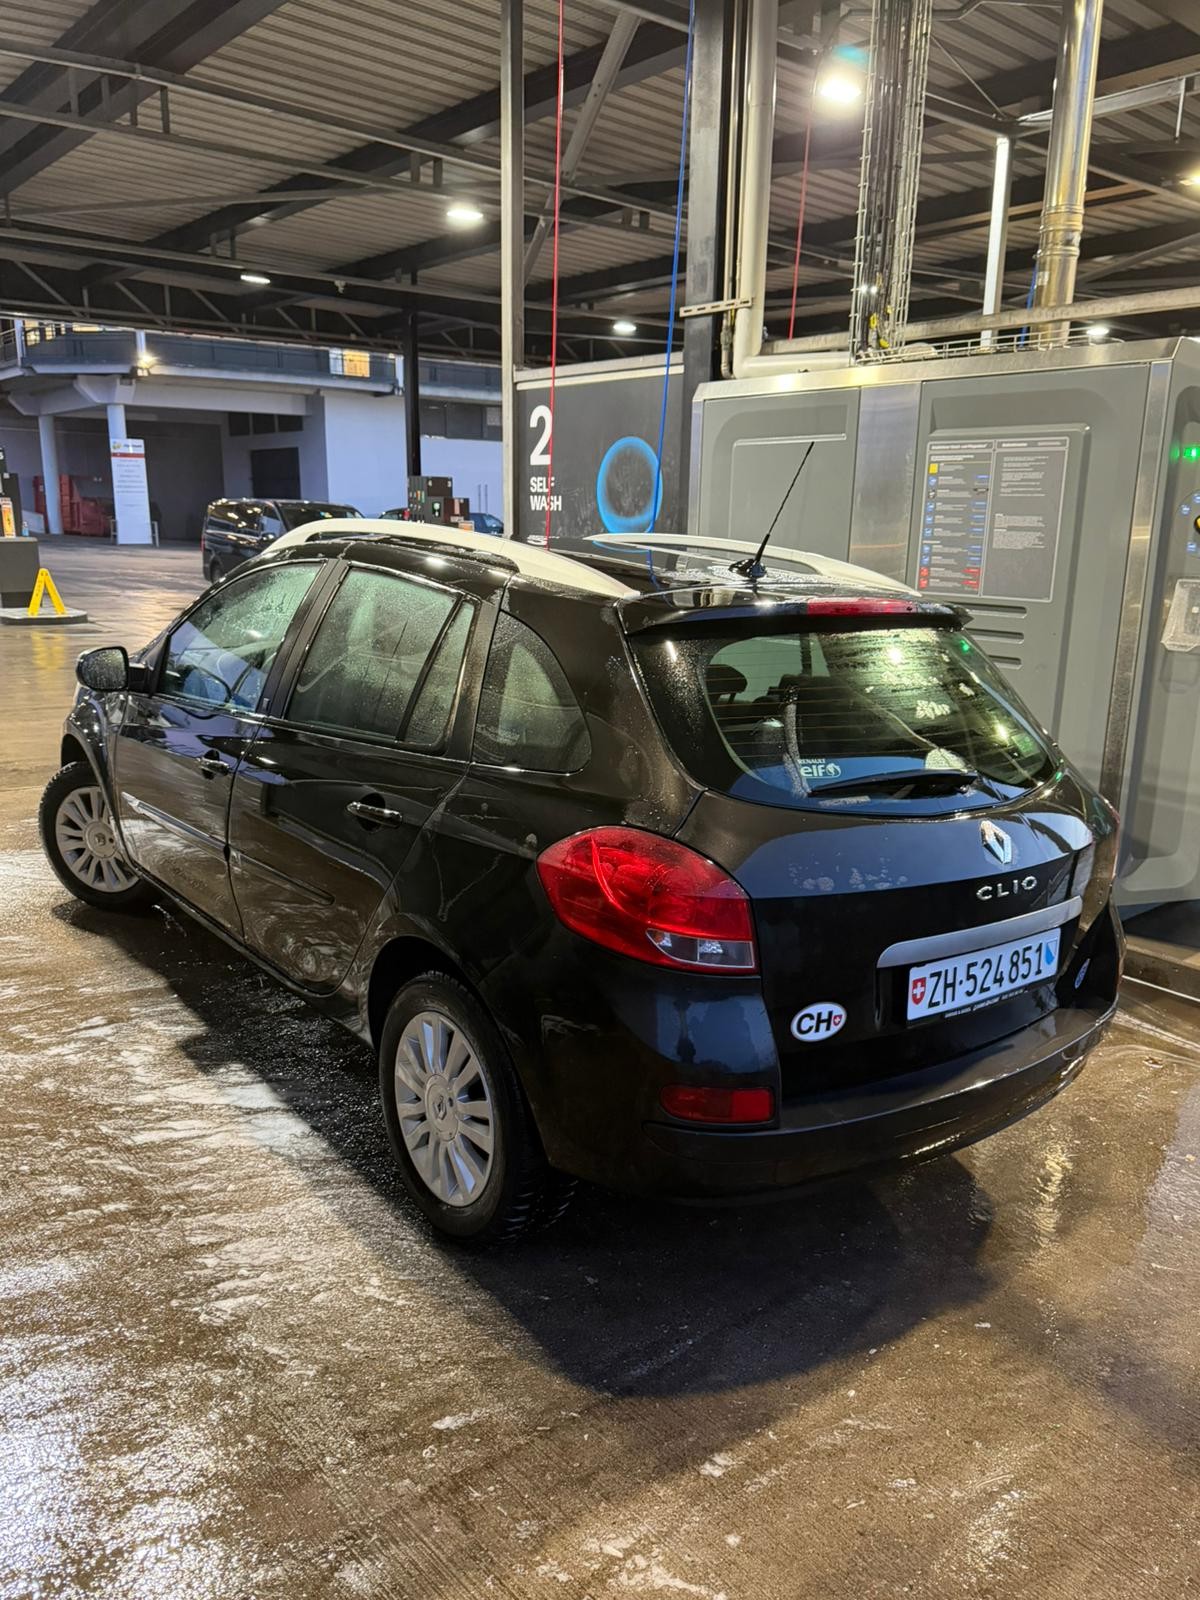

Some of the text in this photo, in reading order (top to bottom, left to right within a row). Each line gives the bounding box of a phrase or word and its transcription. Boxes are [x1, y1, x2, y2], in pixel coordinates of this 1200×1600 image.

[529, 404, 553, 466] 2
[529, 495, 562, 511] WASH
[800, 764, 826, 777] elf
[976, 875, 1038, 900] CLIO
[796, 1010, 832, 1035] CH
